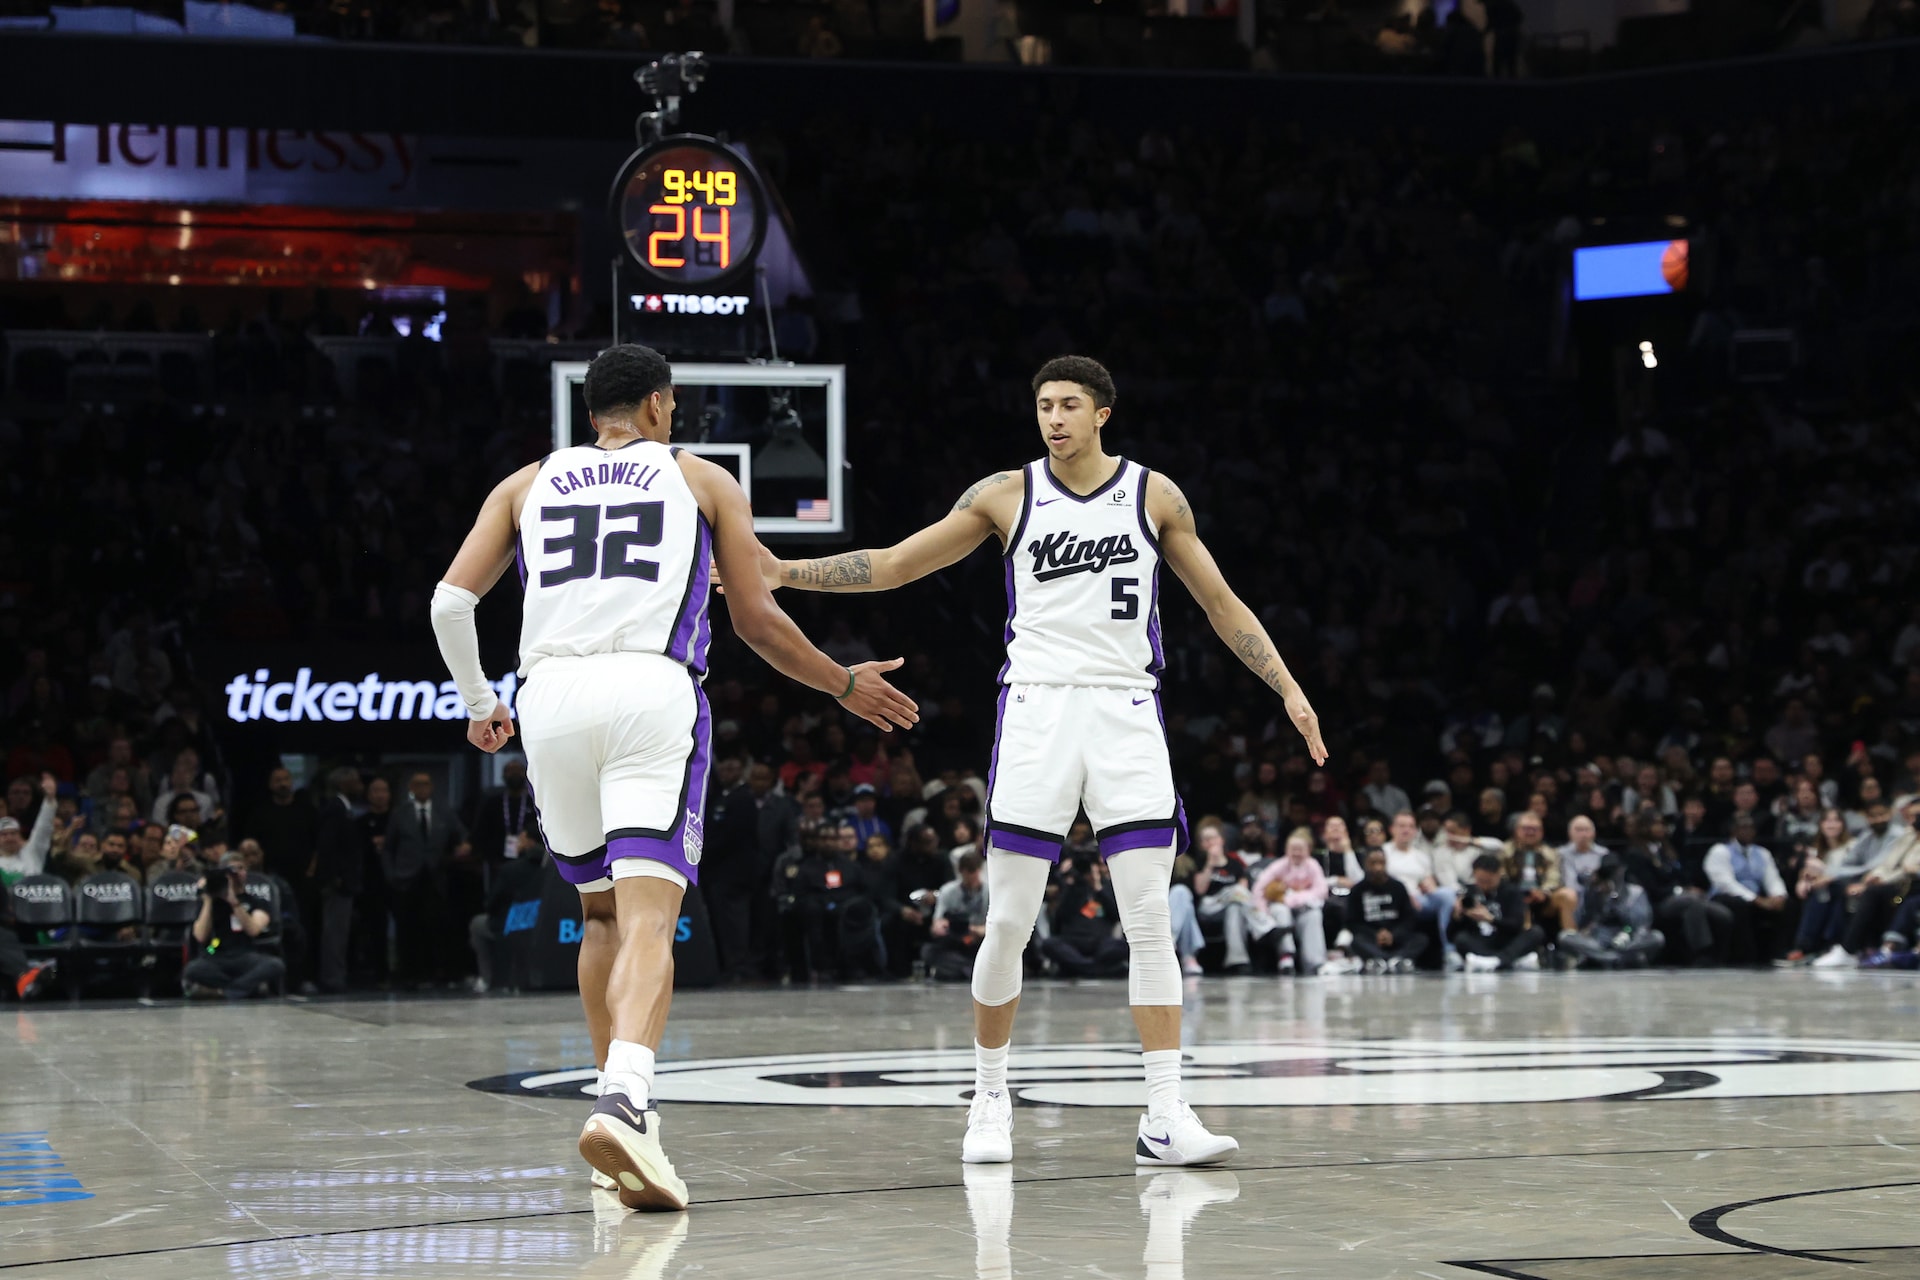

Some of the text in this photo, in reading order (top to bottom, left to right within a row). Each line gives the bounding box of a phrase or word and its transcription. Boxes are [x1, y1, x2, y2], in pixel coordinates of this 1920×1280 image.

[663, 169, 737, 206] 9:49
[648, 204, 729, 269] 24
[662, 294, 750, 315] TISSOT
[550, 462, 661, 495] CARDWELL
[540, 501, 664, 588] 32
[1028, 531, 1138, 583] Kings
[1111, 577, 1139, 620] 5
[225, 667, 517, 723] ticketmat
[14, 884, 62, 899] QATAR
[83, 882, 131, 899] QATAR
